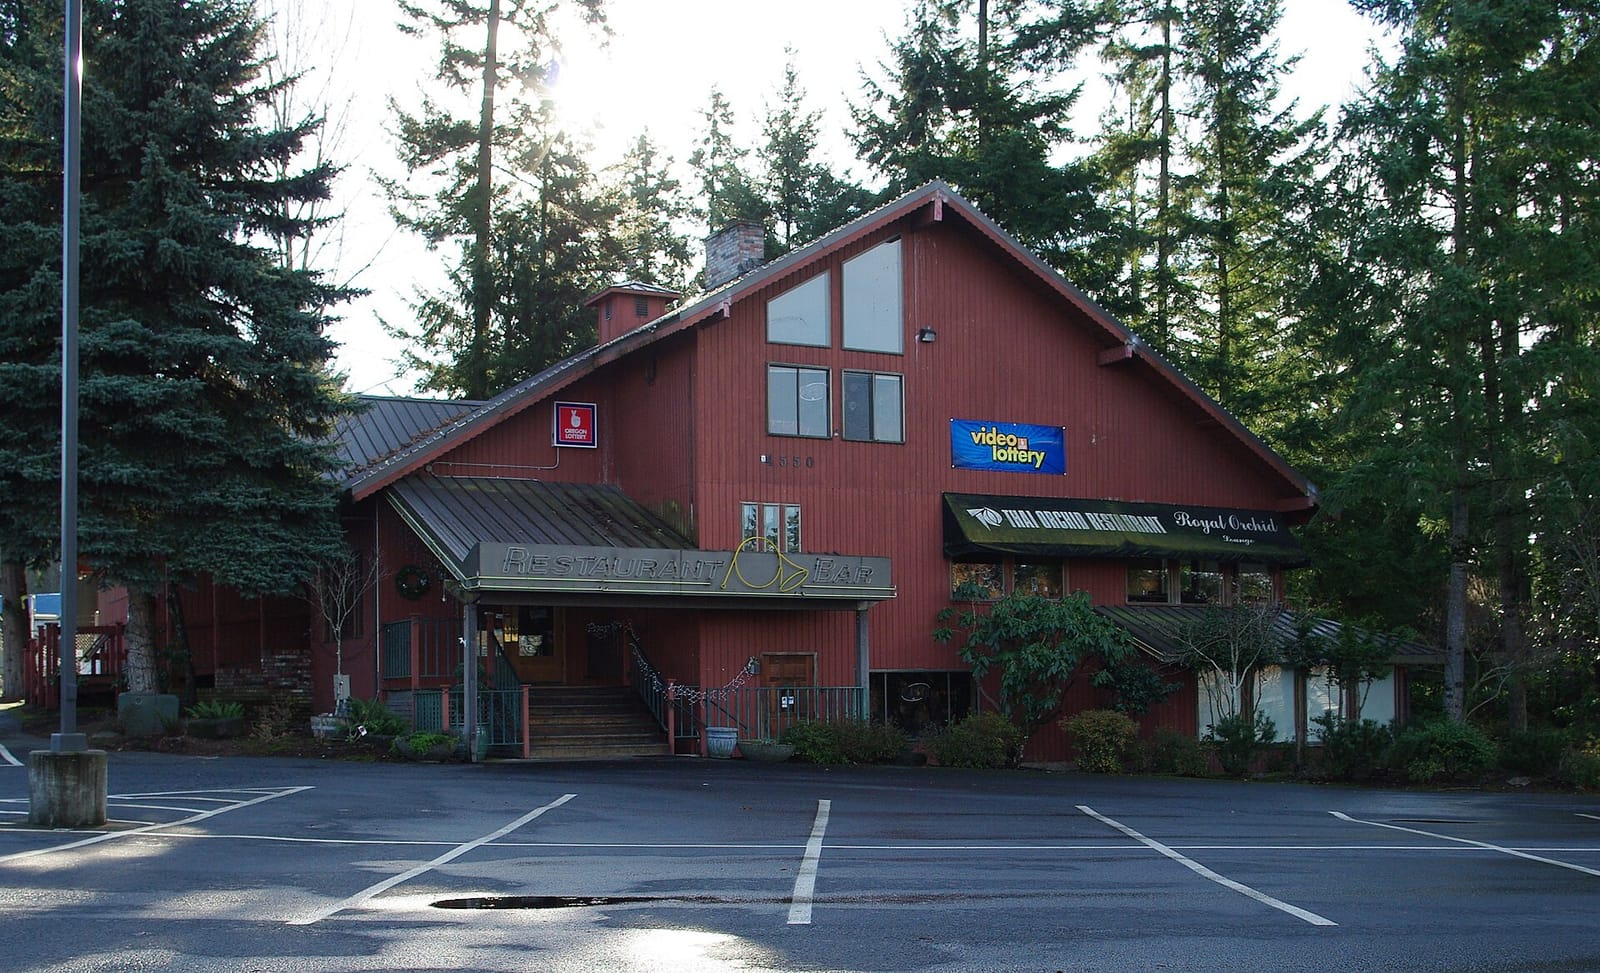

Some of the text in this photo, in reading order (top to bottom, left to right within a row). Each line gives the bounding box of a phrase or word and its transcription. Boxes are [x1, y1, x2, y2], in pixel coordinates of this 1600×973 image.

[970, 426, 1017, 447] video
[992, 445, 1046, 469] lottery
[1001, 509, 1168, 535] THAI ORCHID RESTAURANT
[1173, 511, 1279, 535] Royal Orchid
[502, 546, 874, 584] RESTAURANT BAR
